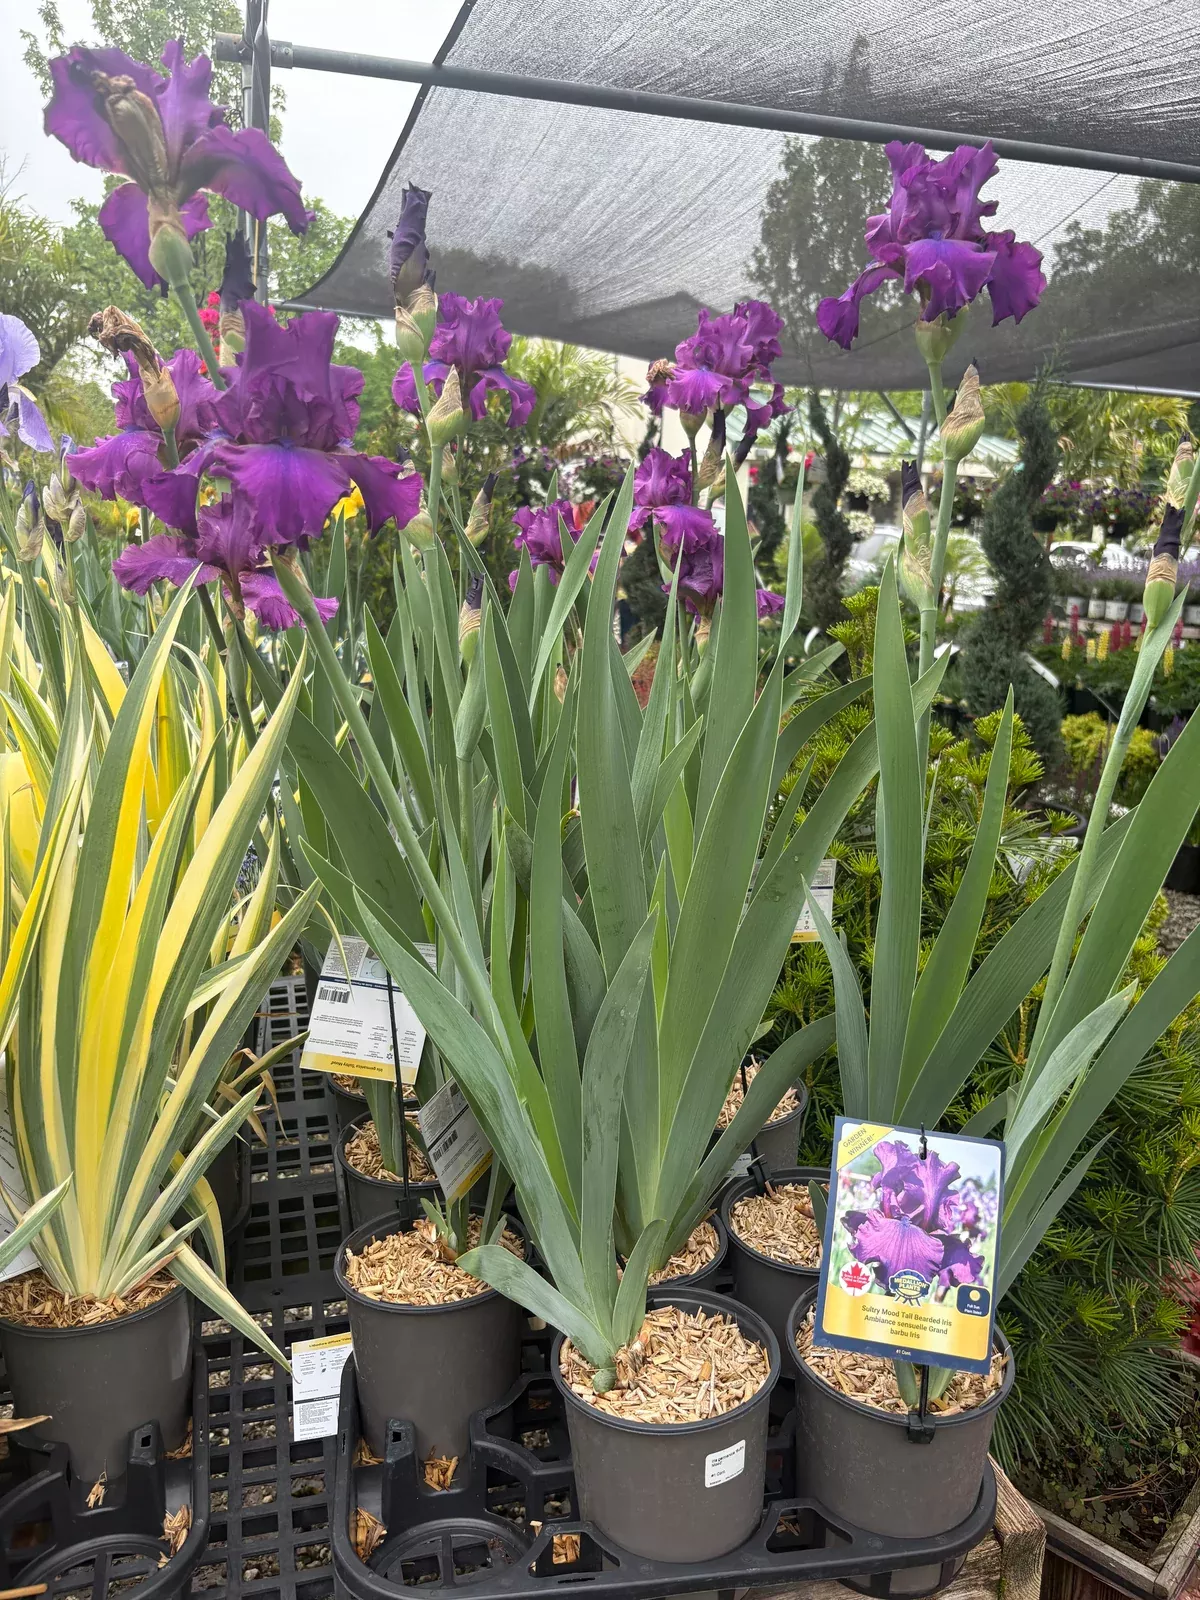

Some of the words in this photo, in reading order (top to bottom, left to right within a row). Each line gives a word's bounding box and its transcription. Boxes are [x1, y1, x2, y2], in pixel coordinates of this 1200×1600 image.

[843, 1127, 867, 1148] GARDEN
[898, 1282, 921, 1292] PLANTS
[862, 1305, 880, 1315] Sultry
[881, 1308, 900, 1317] Mood
[901, 1311, 913, 1319] Tall
[914, 1314, 941, 1325] Bearded
[941, 1319, 952, 1327] Iris
[864, 1314, 896, 1326] Ambiance
[897, 1321, 928, 1331] sensuelle
[928, 1326, 948, 1335] Grand
[890, 1328, 909, 1337] barbu
[909, 1331, 920, 1339] Iris
